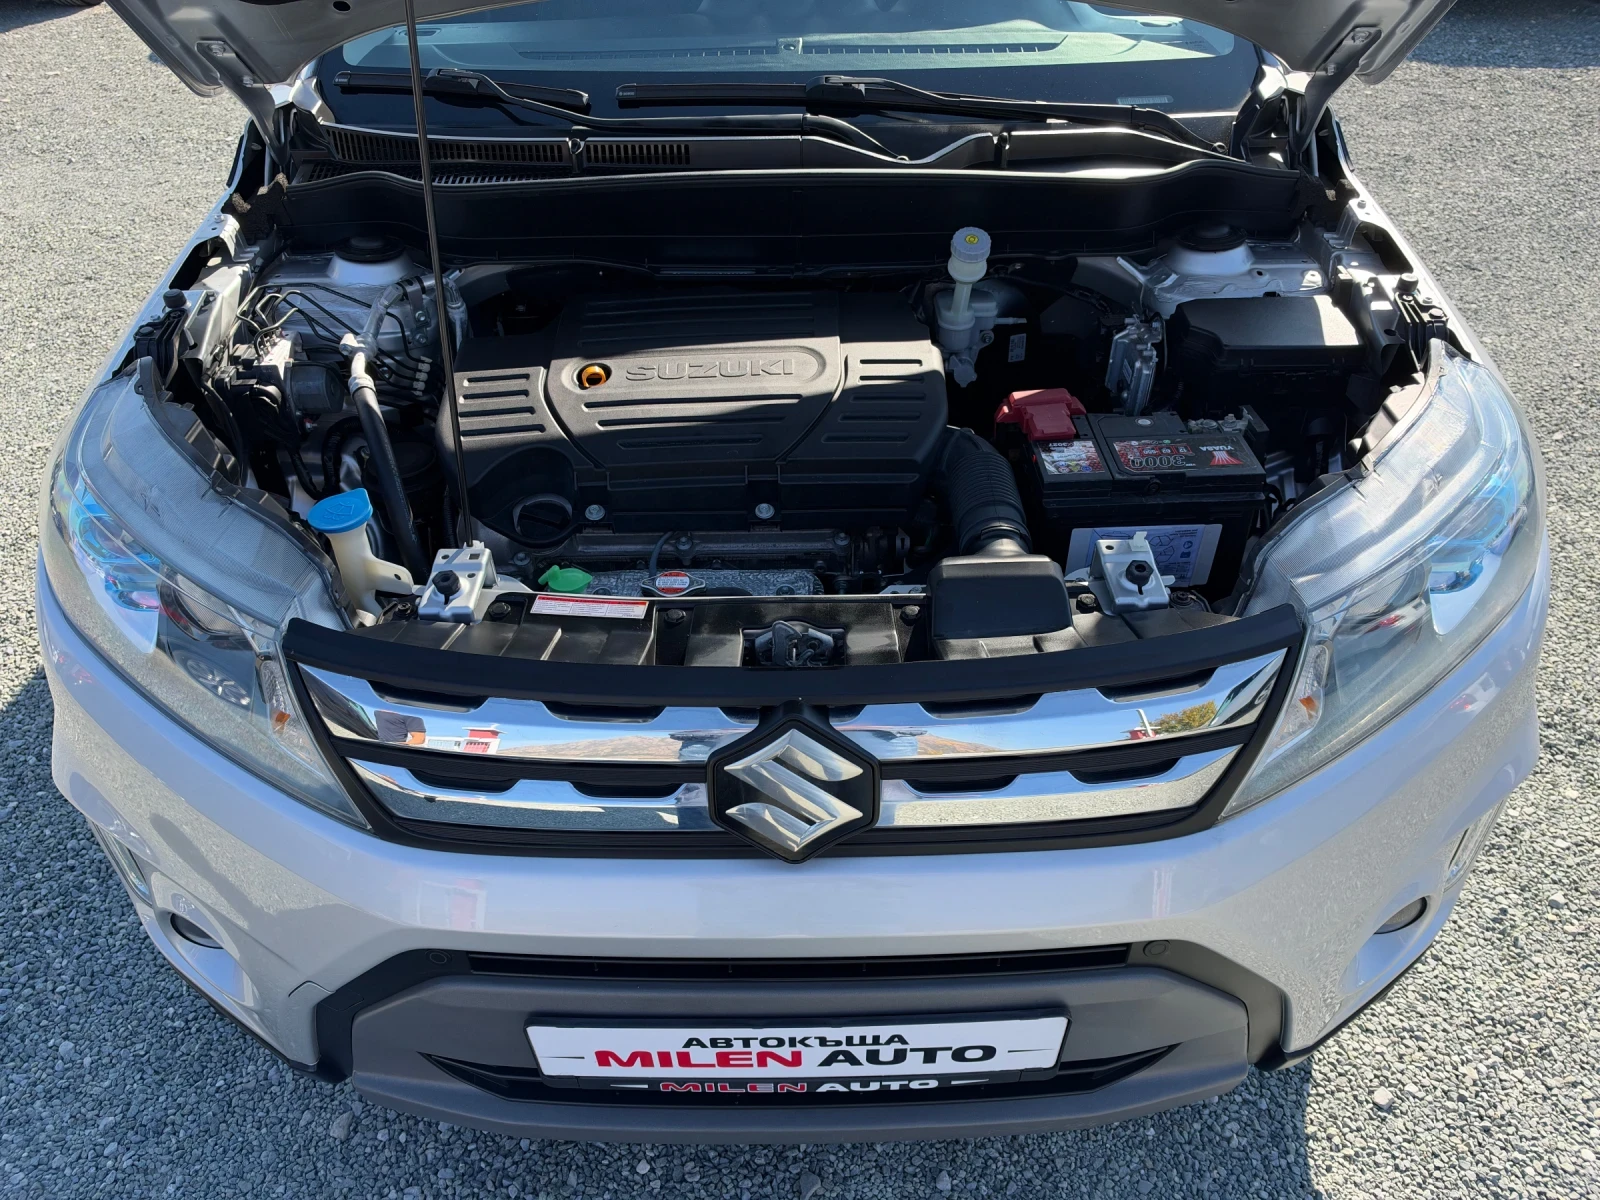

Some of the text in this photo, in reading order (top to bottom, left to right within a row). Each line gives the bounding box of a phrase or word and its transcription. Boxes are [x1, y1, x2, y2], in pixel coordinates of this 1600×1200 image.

[626, 358, 795, 382] SUZUKI
[1130, 454, 1186, 469] 3000
[681, 1034, 910, 1049] АВТОКЪША
[594, 1045, 997, 1068] MILEN AUTO
[659, 1079, 939, 1093] MILEN AUTO
